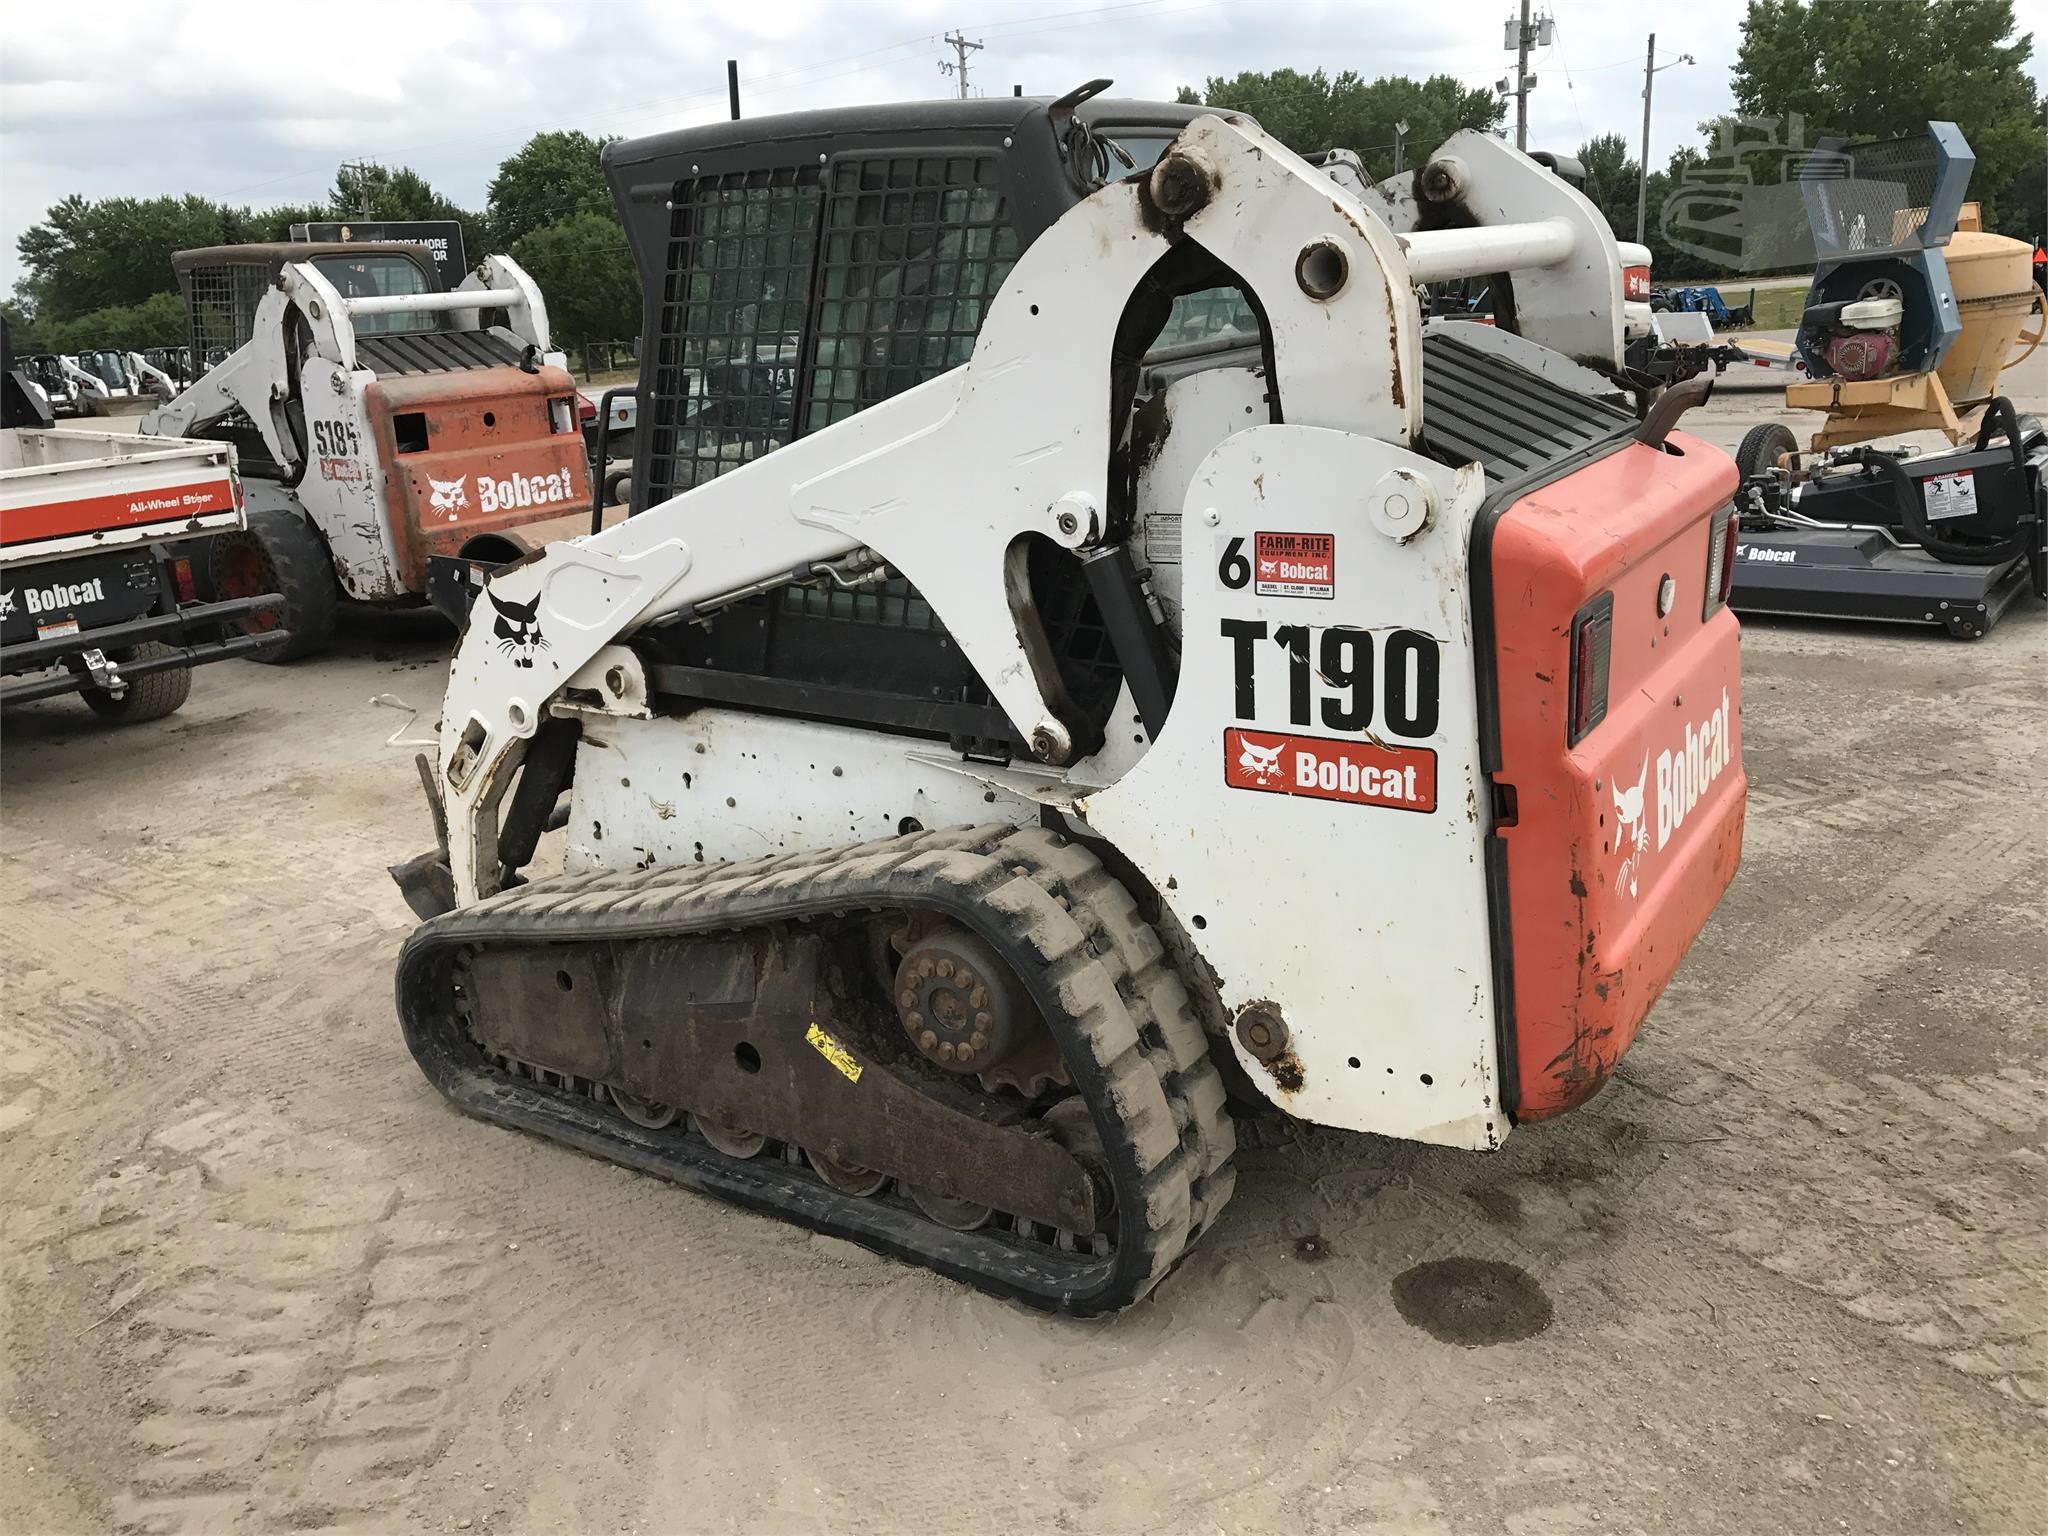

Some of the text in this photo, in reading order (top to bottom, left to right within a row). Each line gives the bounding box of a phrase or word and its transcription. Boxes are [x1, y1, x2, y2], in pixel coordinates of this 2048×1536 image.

[419, 238, 448, 249] MORE
[432, 250, 448, 261] OR
[1938, 472, 1959, 480] DANGER
[477, 466, 573, 513] Bobcat
[130, 493, 213, 513] All-Wheel Steer
[1259, 536, 1330, 551] FARM-RITE
[1218, 537, 1251, 590] 6
[1259, 550, 1308, 558] EQUIPMENT
[1748, 547, 1796, 562] Bobcat
[1280, 561, 1328, 580] Bobcat
[24, 577, 104, 614] Bobcat
[1221, 618, 1440, 738] T190
[1296, 751, 1417, 801] Bobcat
[1657, 685, 1730, 853] Bobcat
